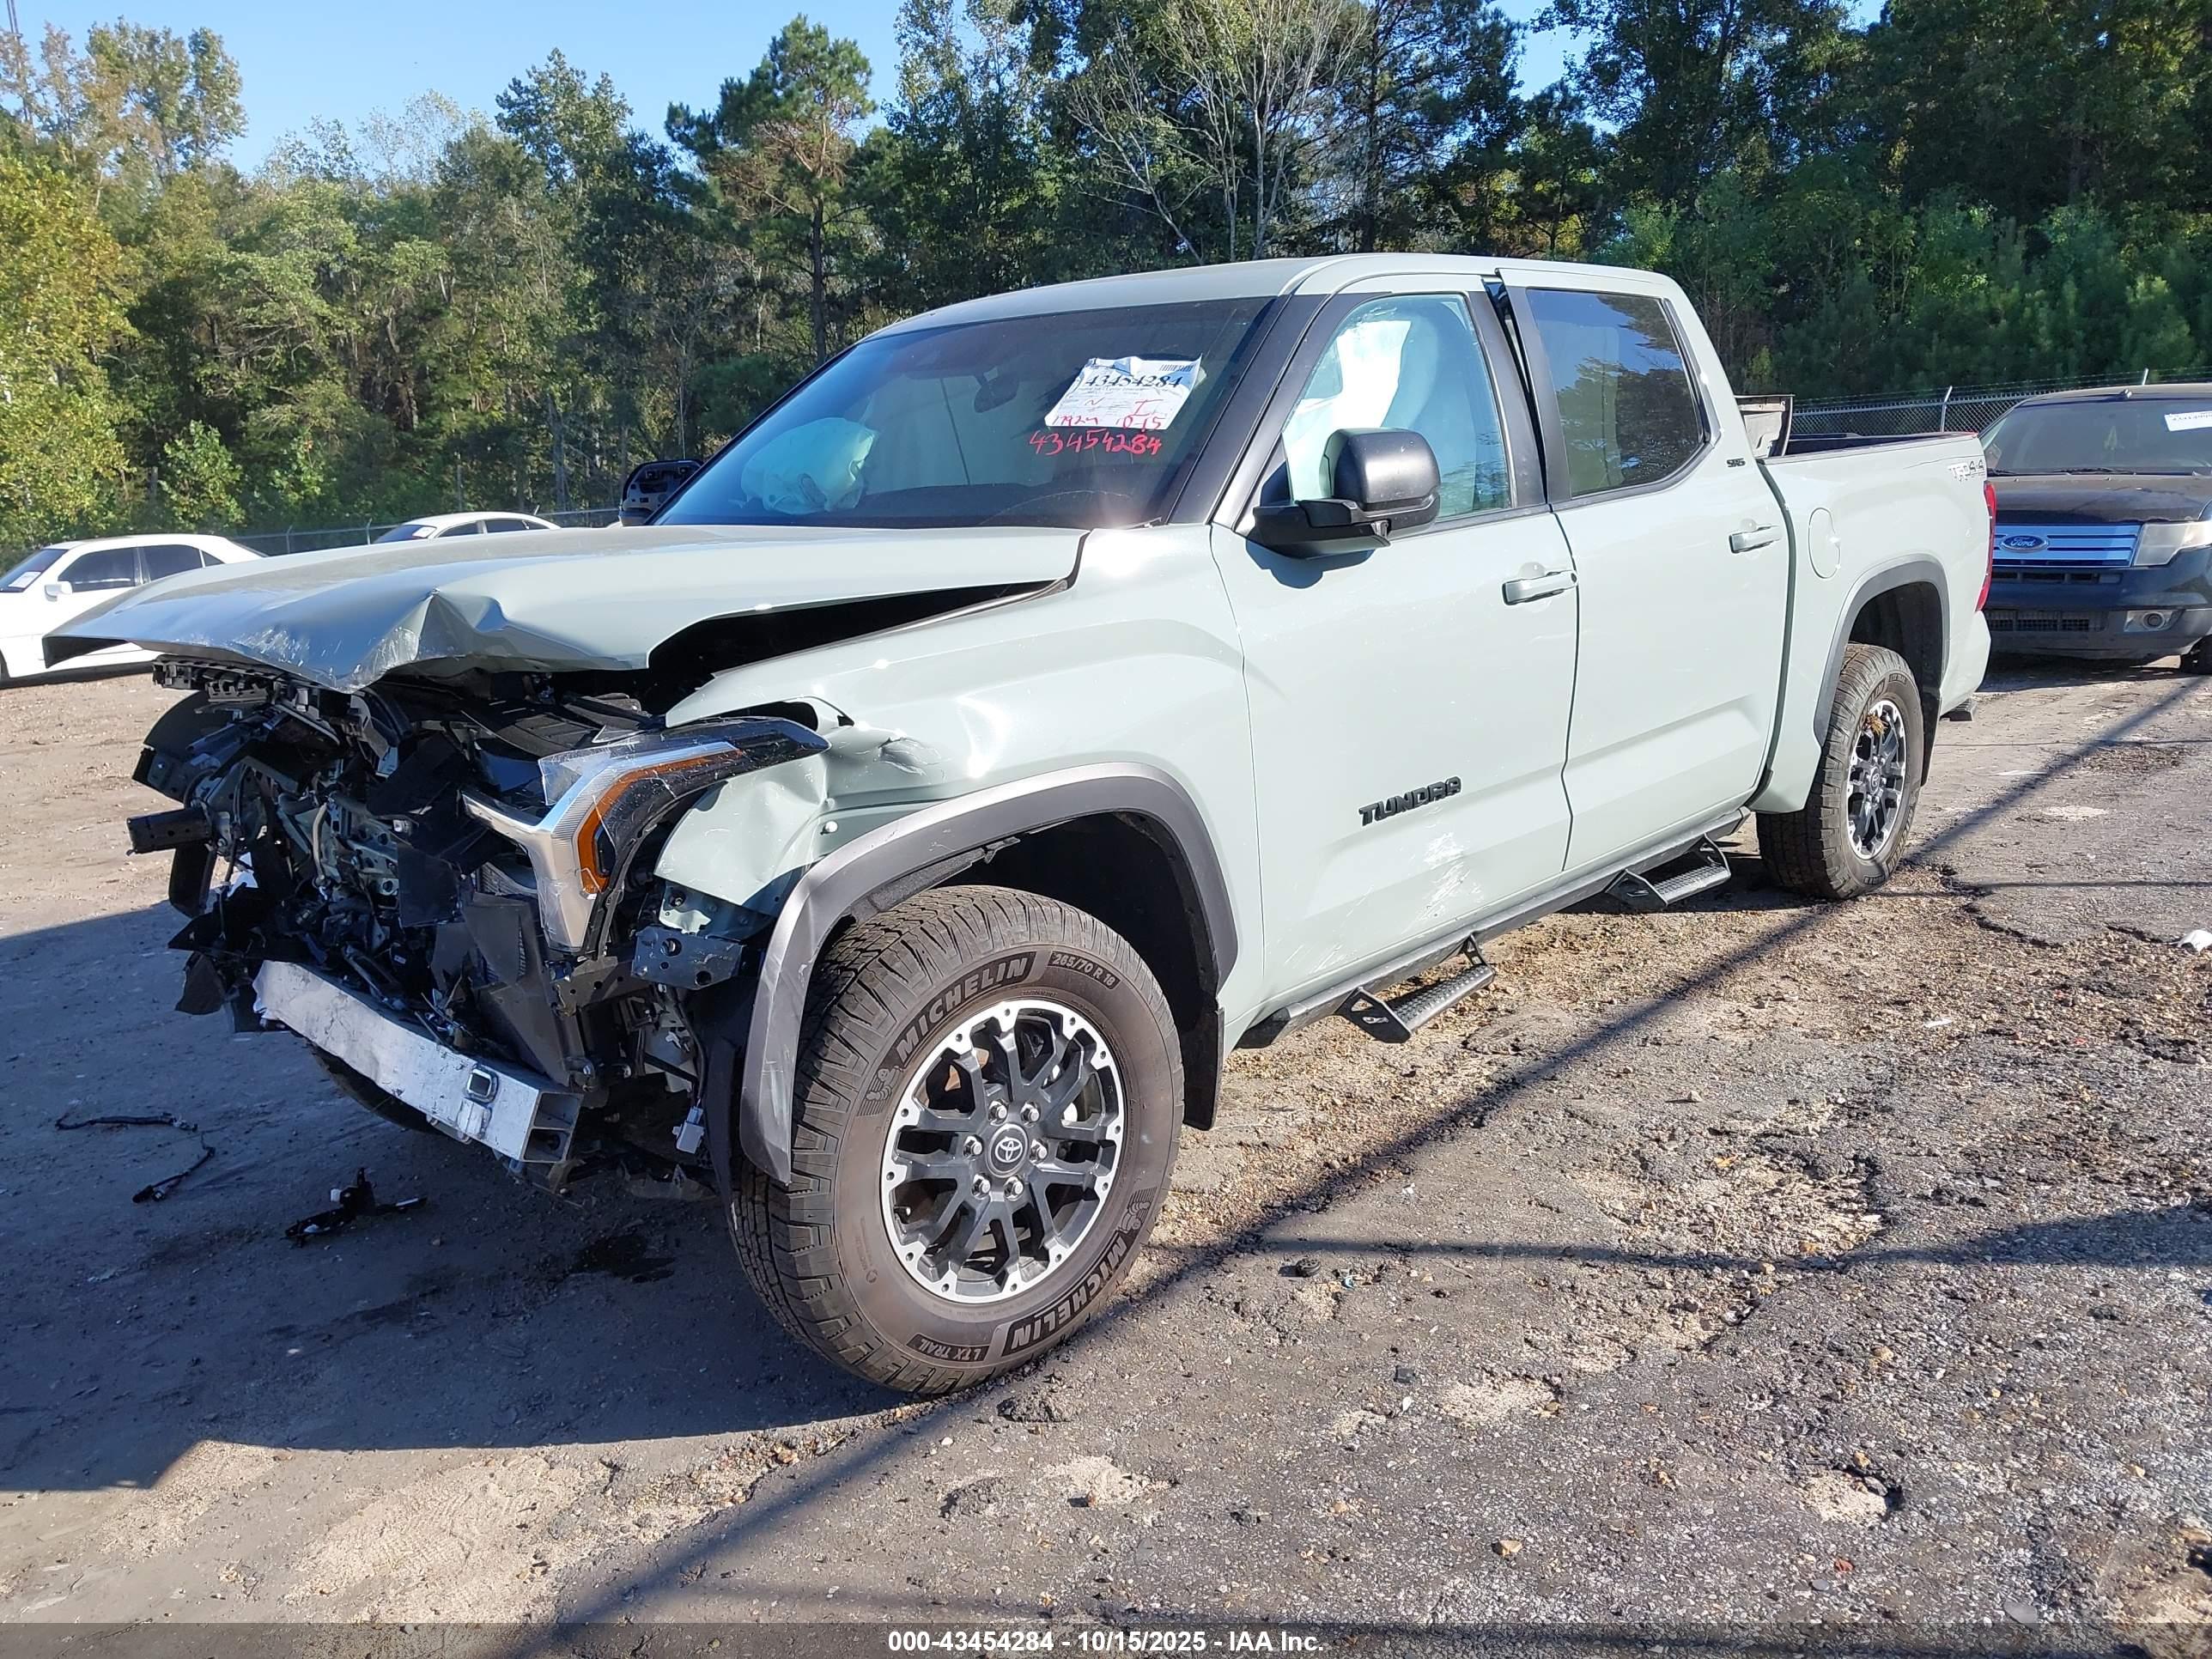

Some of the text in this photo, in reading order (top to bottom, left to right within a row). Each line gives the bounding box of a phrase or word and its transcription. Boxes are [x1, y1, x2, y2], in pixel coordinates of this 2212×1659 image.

[1085, 374, 1183, 388] 43454284
[1029, 428, 1162, 455] 43454284
[2010, 537, 2036, 547] Ford
[1358, 776, 1462, 826] TUNDRA
[1093, 967, 1103, 979] R
[1103, 973, 1115, 987] 18
[896, 957, 1029, 1063] MICHELIN
[1011, 1236, 1127, 1350] MICHELIN
[919, 1339, 982, 1361] LTX TRAIL
